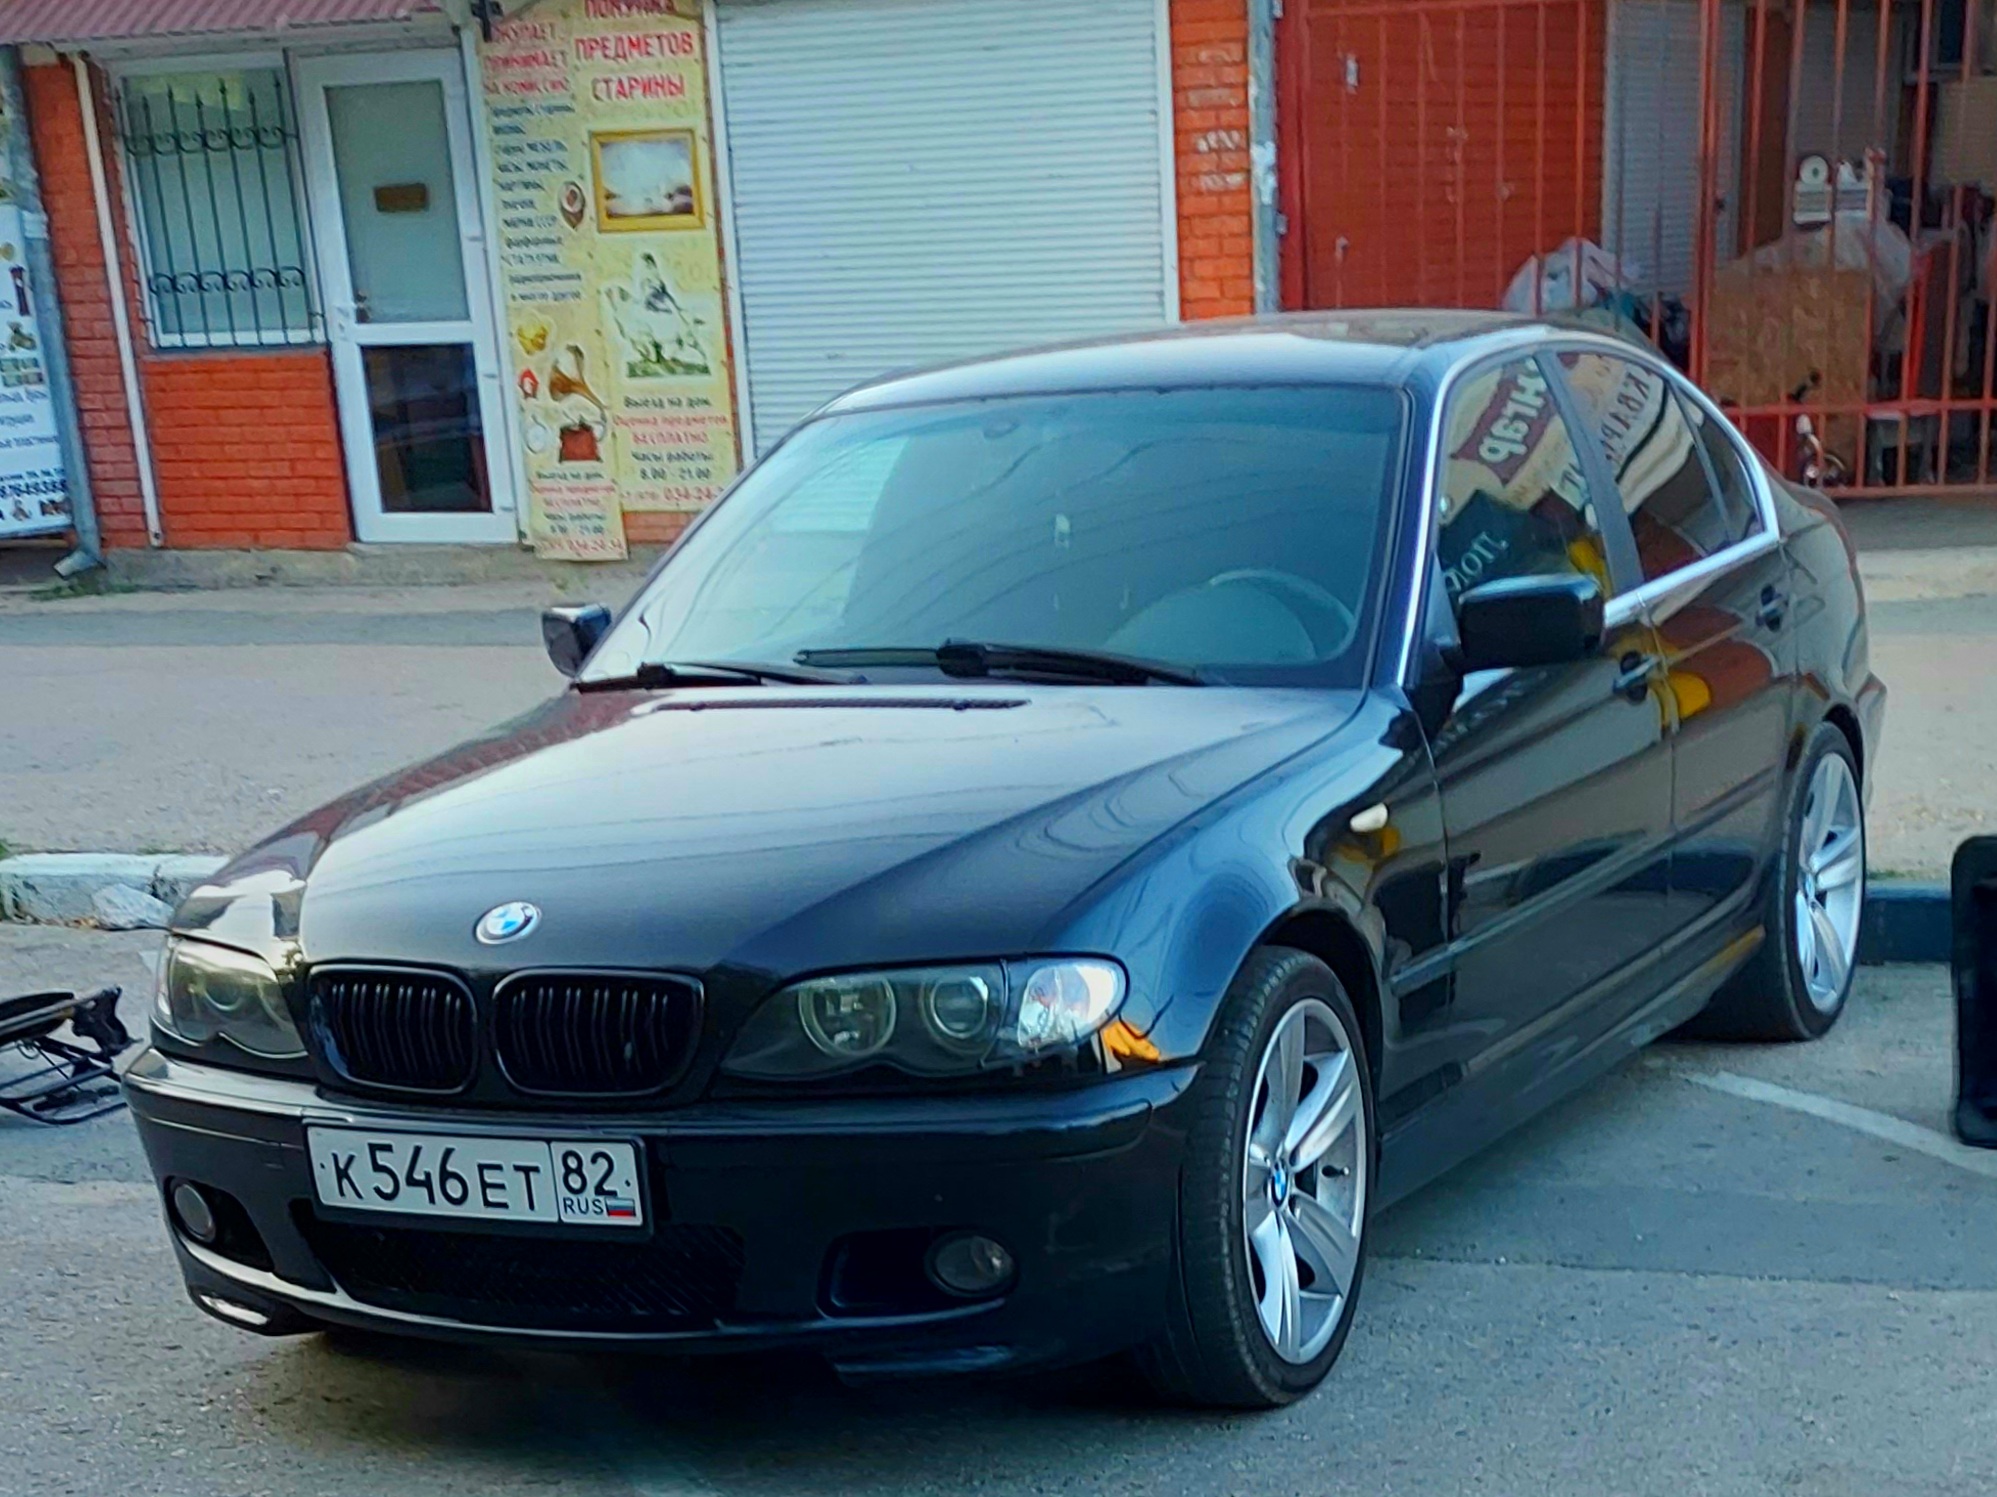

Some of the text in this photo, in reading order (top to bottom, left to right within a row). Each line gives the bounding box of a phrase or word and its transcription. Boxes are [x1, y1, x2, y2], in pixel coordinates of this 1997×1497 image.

[575, 31, 694, 64] ПРЕДМЕТОВ
[591, 74, 687, 102] СТАРИНЫ
[632, 431, 709, 446] БЕСПЛАТНО
[562, 1150, 618, 1197] 82
[563, 1197, 605, 1216] RUS
